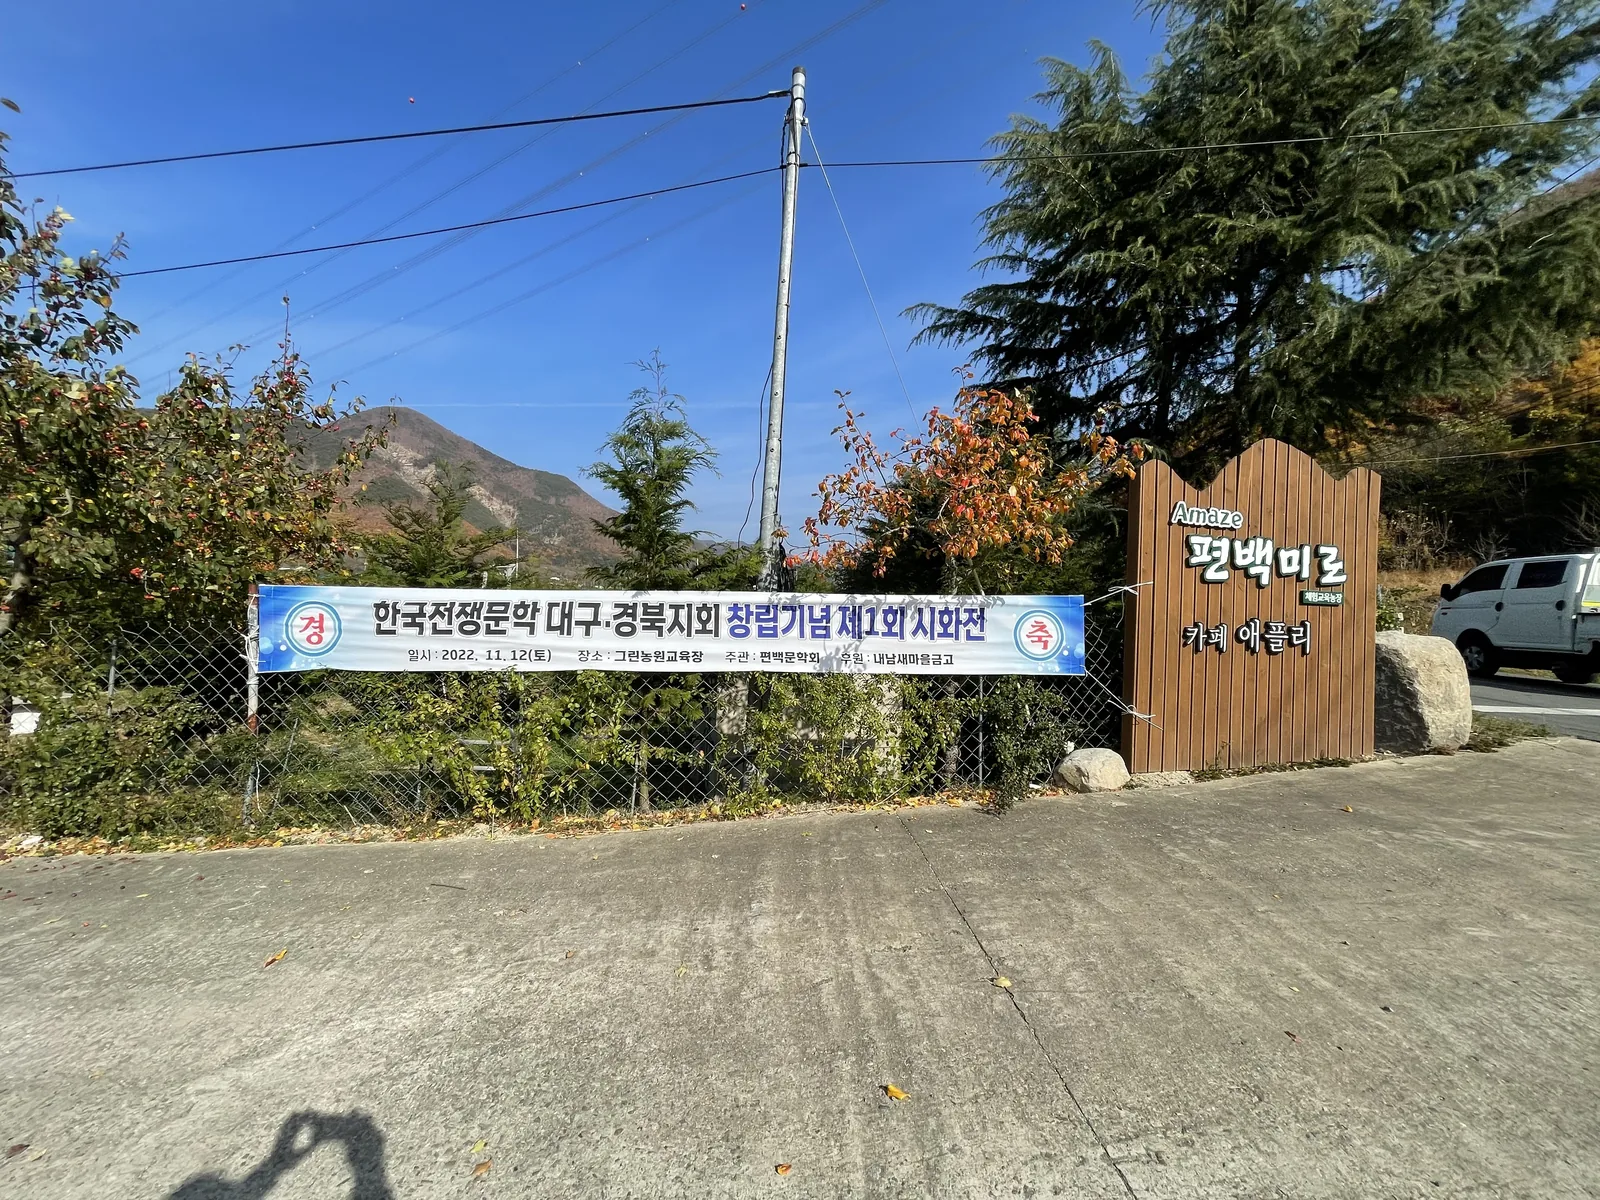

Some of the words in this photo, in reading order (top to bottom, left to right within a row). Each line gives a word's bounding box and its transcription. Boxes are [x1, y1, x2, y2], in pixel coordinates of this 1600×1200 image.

[1172, 501, 1243, 528] Amaze
[298, 613, 326, 646] 경
[373, 601, 540, 636] 한국전쟁문학
[727, 603, 831, 640] 창립기념
[838, 605, 905, 641] 제1회
[911, 605, 986, 642] 시화전
[1025, 621, 1053, 650] 축
[1186, 622, 1229, 652] 카페
[1239, 618, 1311, 654] 애플리
[614, 650, 704, 663] 그린농원교육장
[760, 651, 820, 664] 편백문학회
[873, 653, 954, 666] 내남새마을금고
